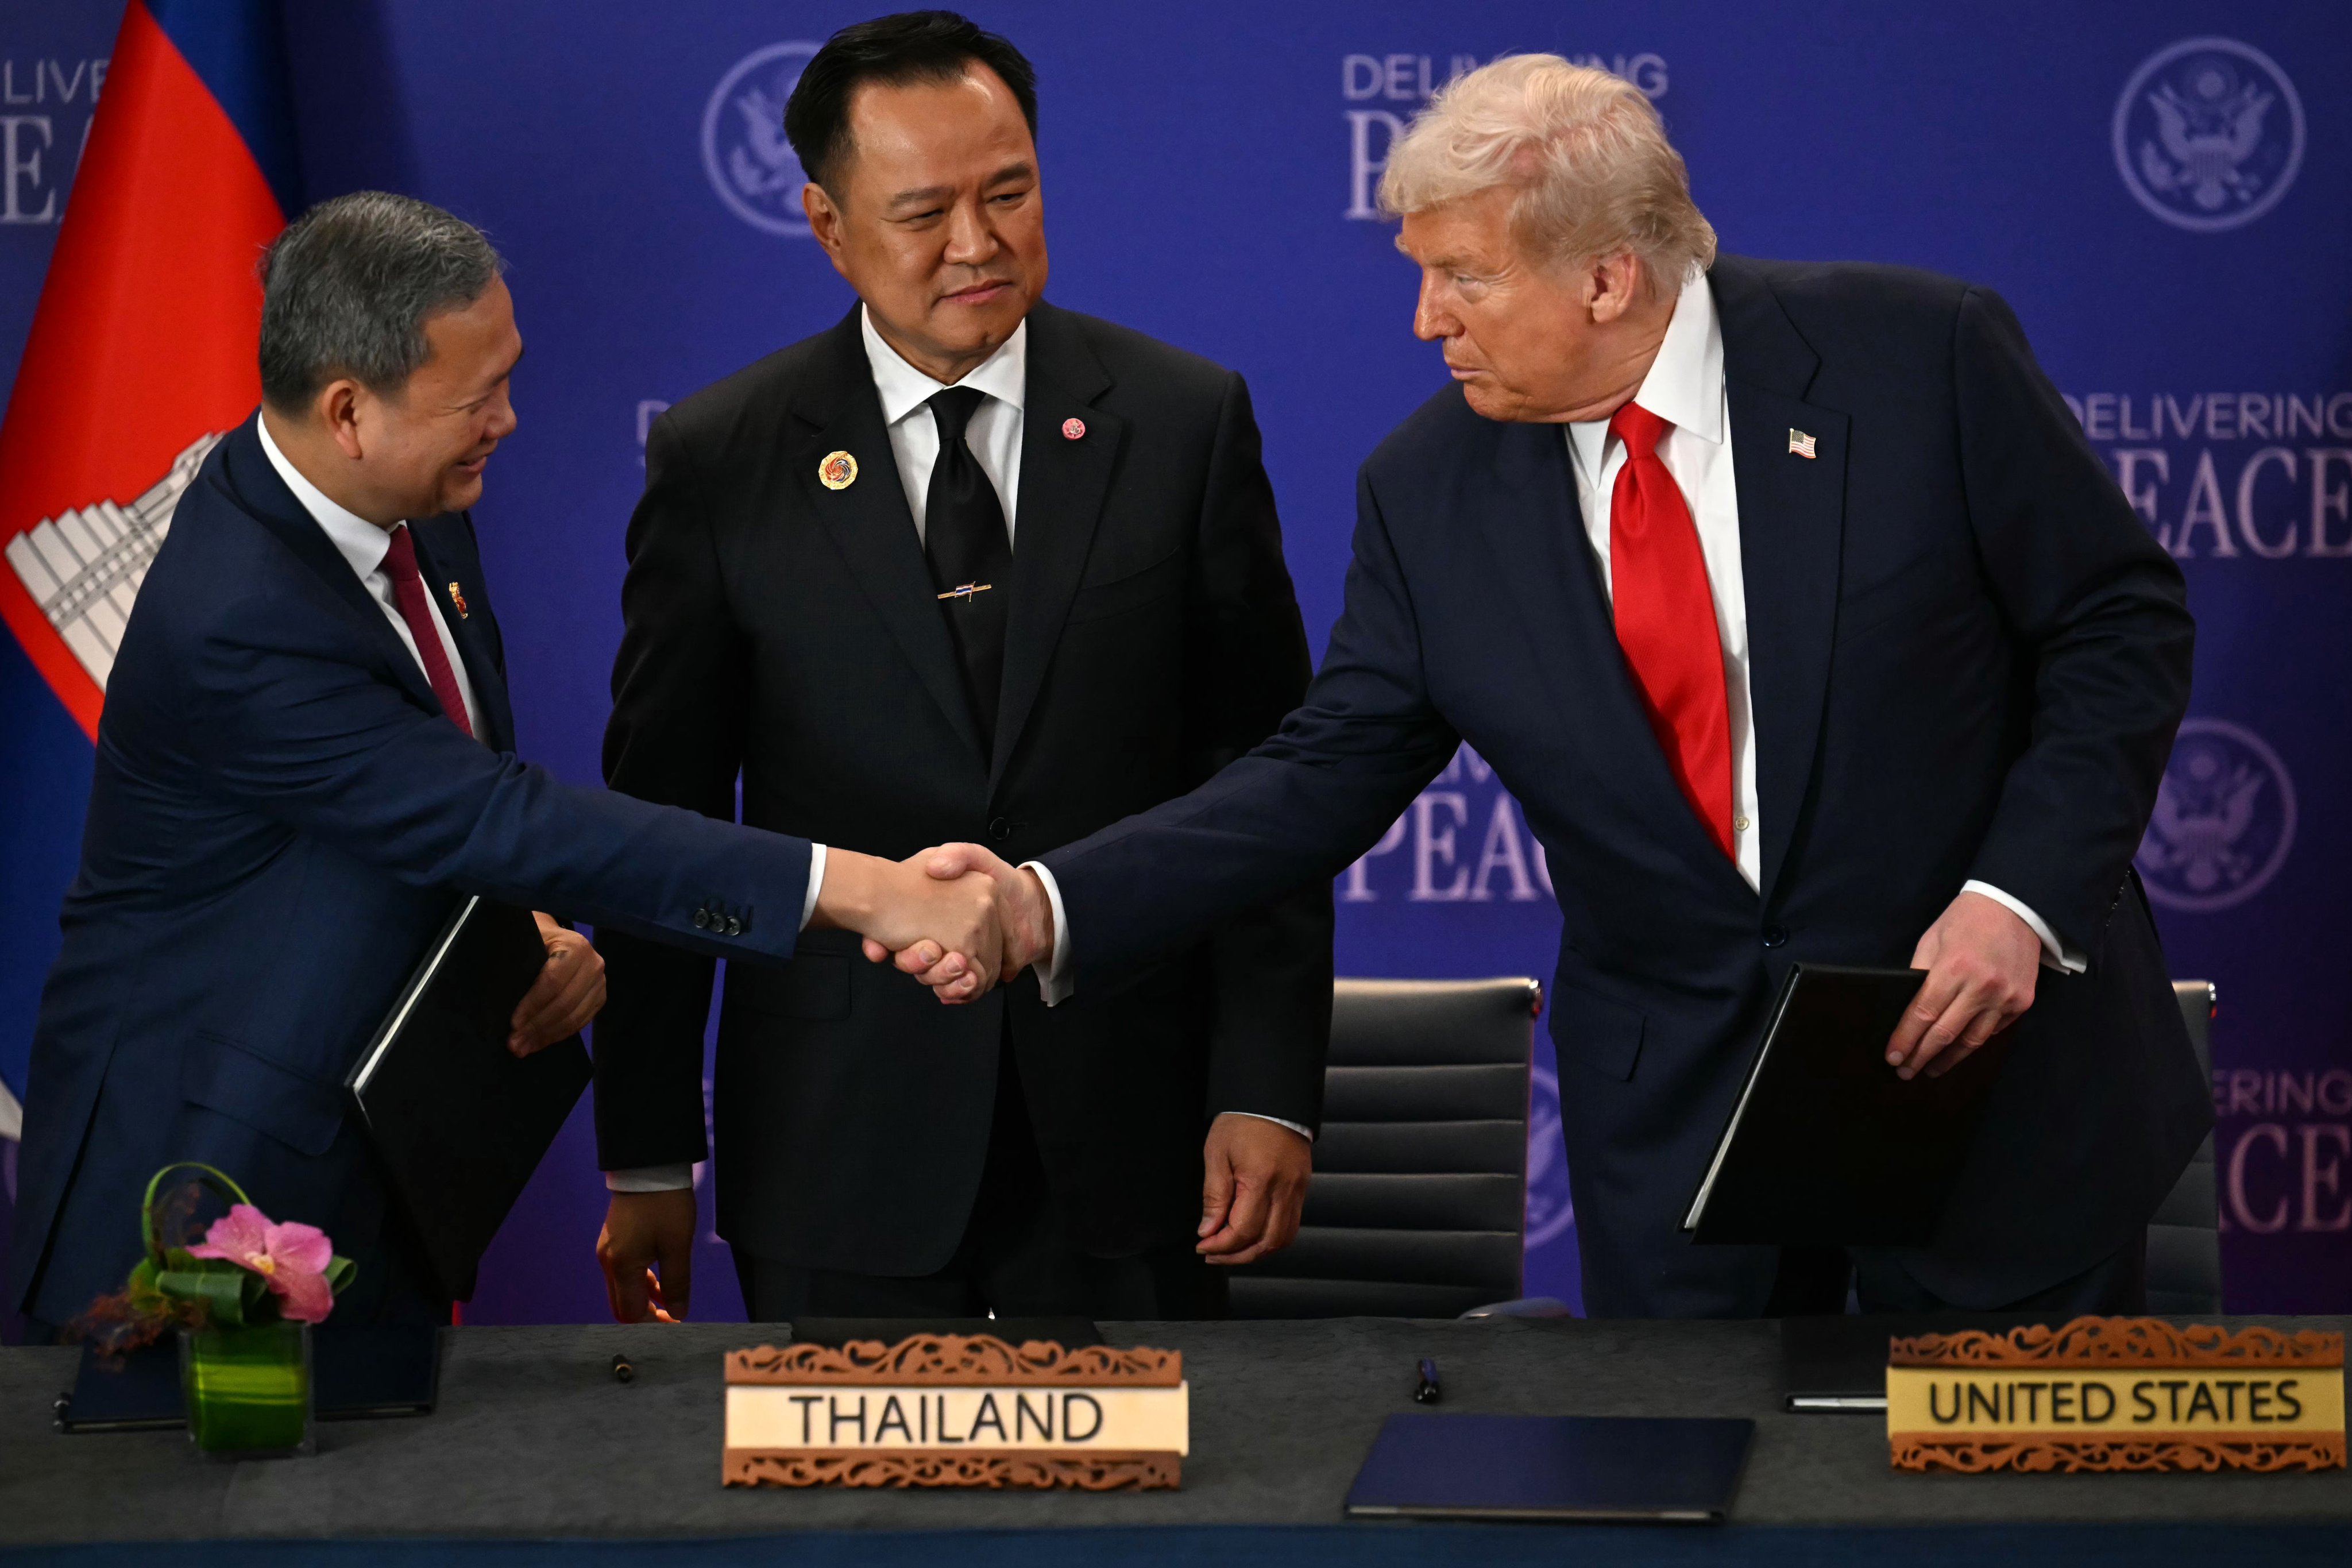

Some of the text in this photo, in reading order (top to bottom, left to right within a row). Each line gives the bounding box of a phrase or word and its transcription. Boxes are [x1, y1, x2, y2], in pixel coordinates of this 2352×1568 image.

[2111, 447, 2352, 558] EACE
[789, 1393, 1103, 1443] THAILAND
[1929, 1378, 2303, 1425] UNITED STATES
